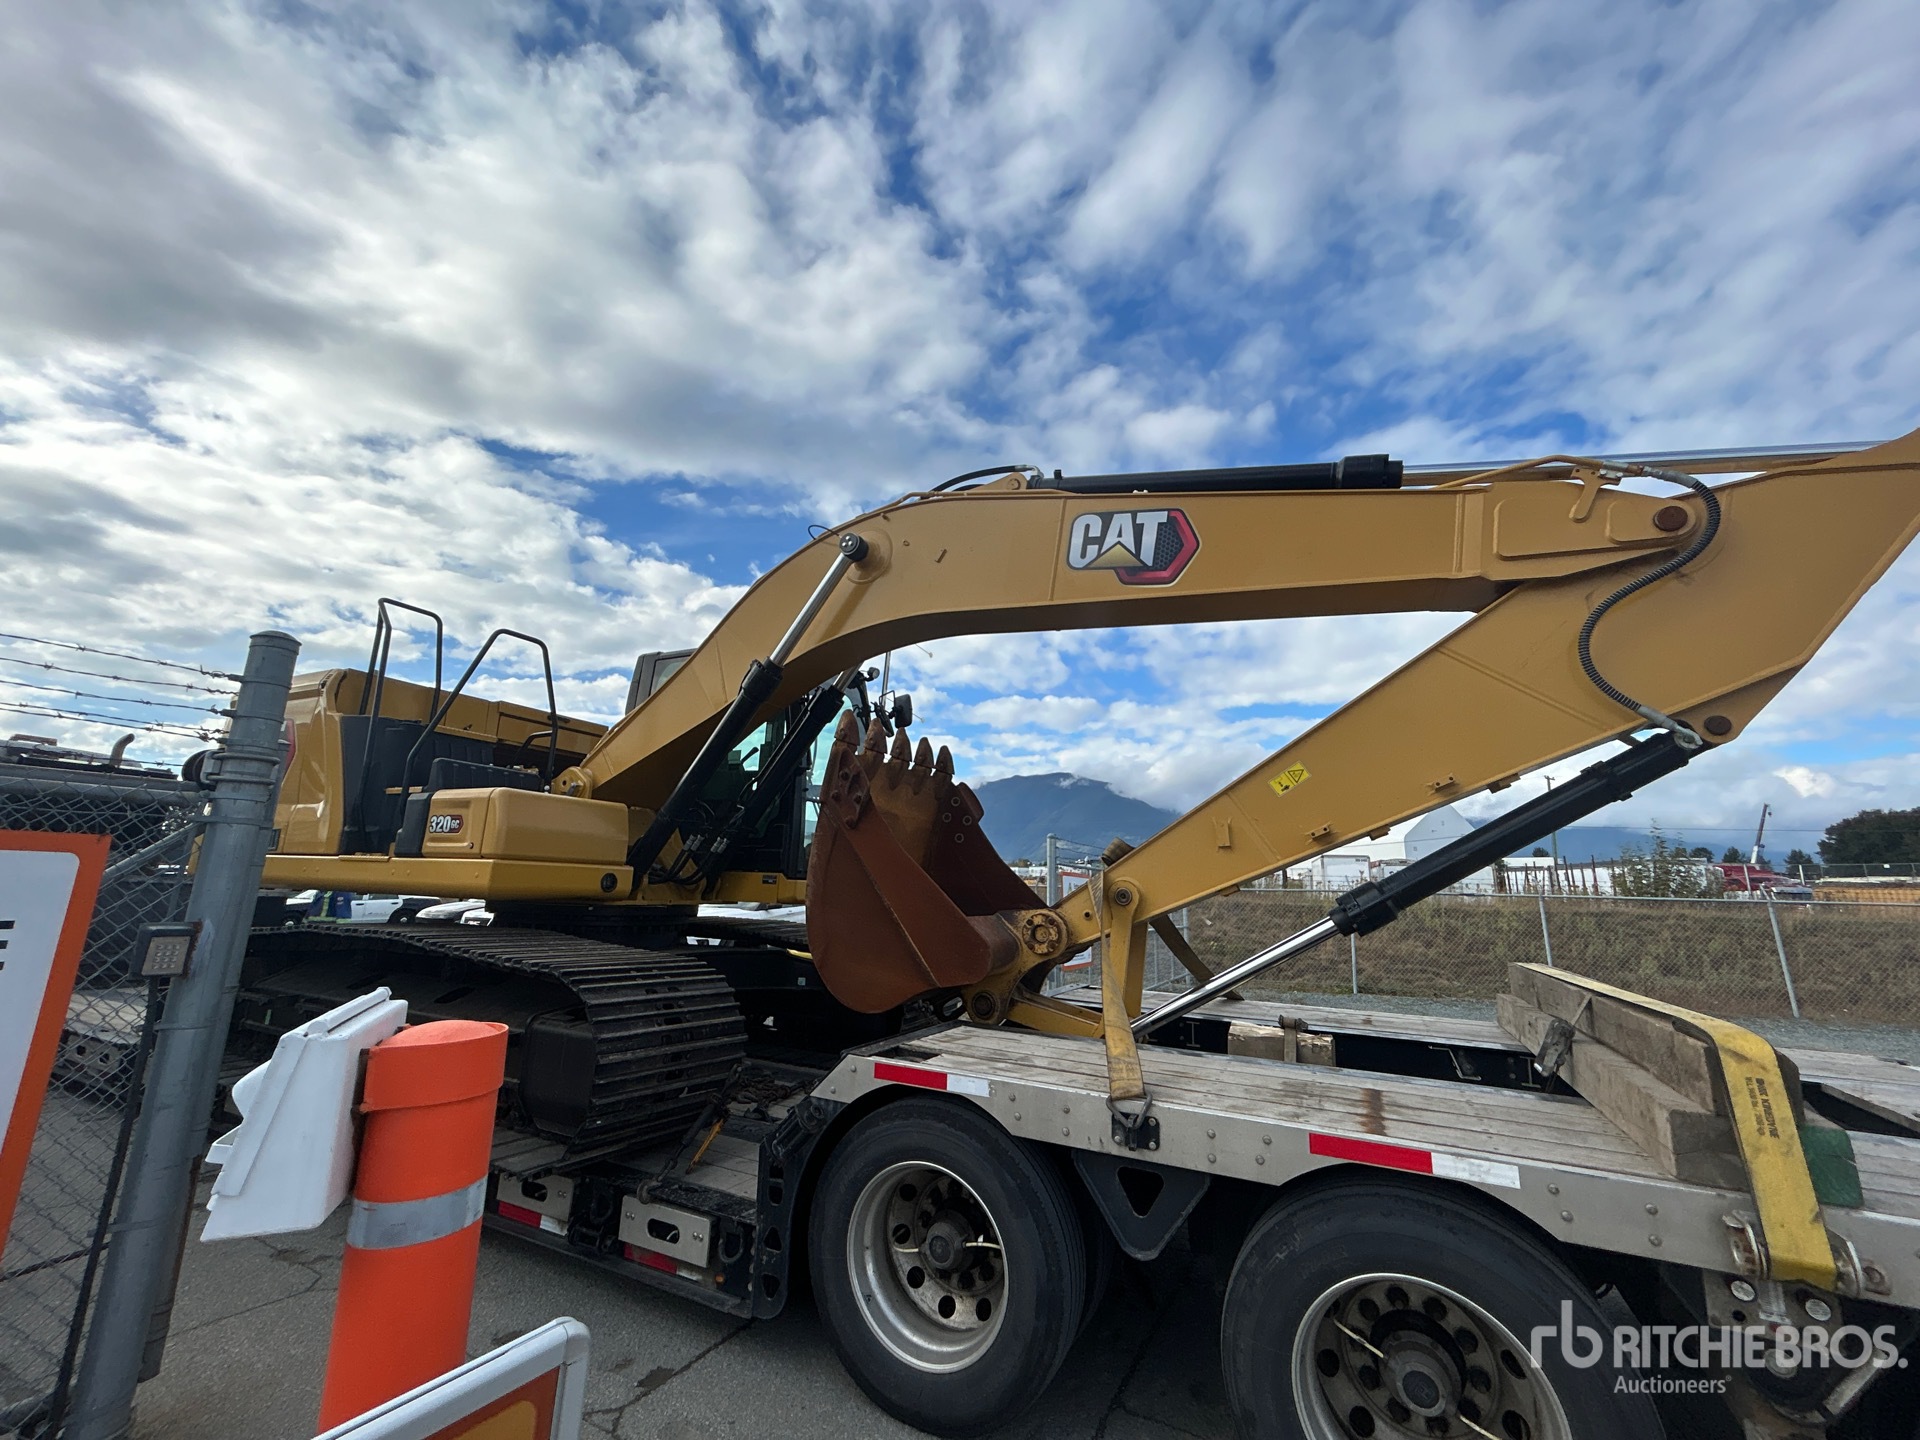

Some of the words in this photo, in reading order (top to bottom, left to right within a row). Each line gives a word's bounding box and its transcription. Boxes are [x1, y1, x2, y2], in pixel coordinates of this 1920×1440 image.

[1069, 511, 1168, 568] CAT
[430, 815, 451, 832] 320
[451, 820, 460, 828] GC
